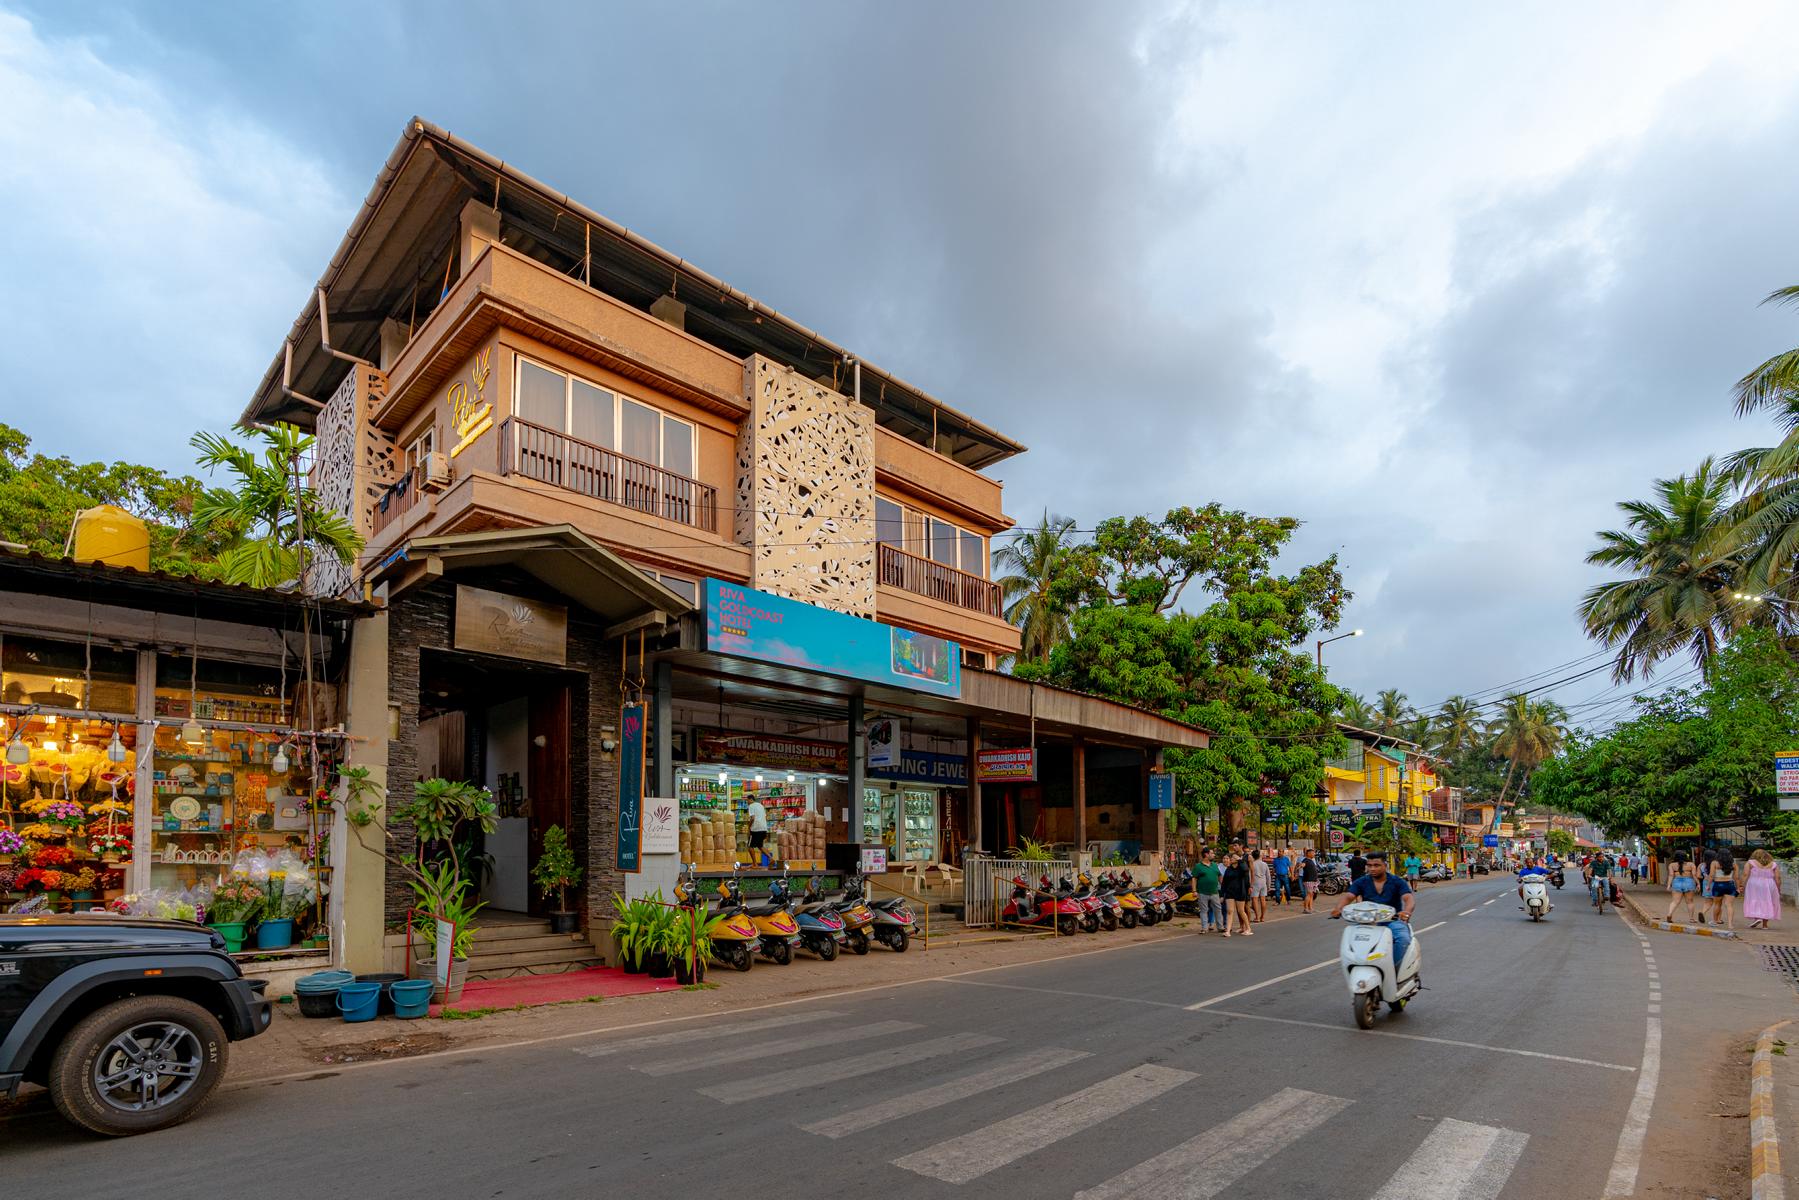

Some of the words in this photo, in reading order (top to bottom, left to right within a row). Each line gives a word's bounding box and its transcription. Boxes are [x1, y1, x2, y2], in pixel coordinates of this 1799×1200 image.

[720, 586, 747, 602] RIVA
[720, 600, 784, 624] GOLDCOAST
[720, 612, 752, 628] HOTEL
[811, 746, 836, 758] KAJU
[208, 1041, 217, 1063] CEAT
